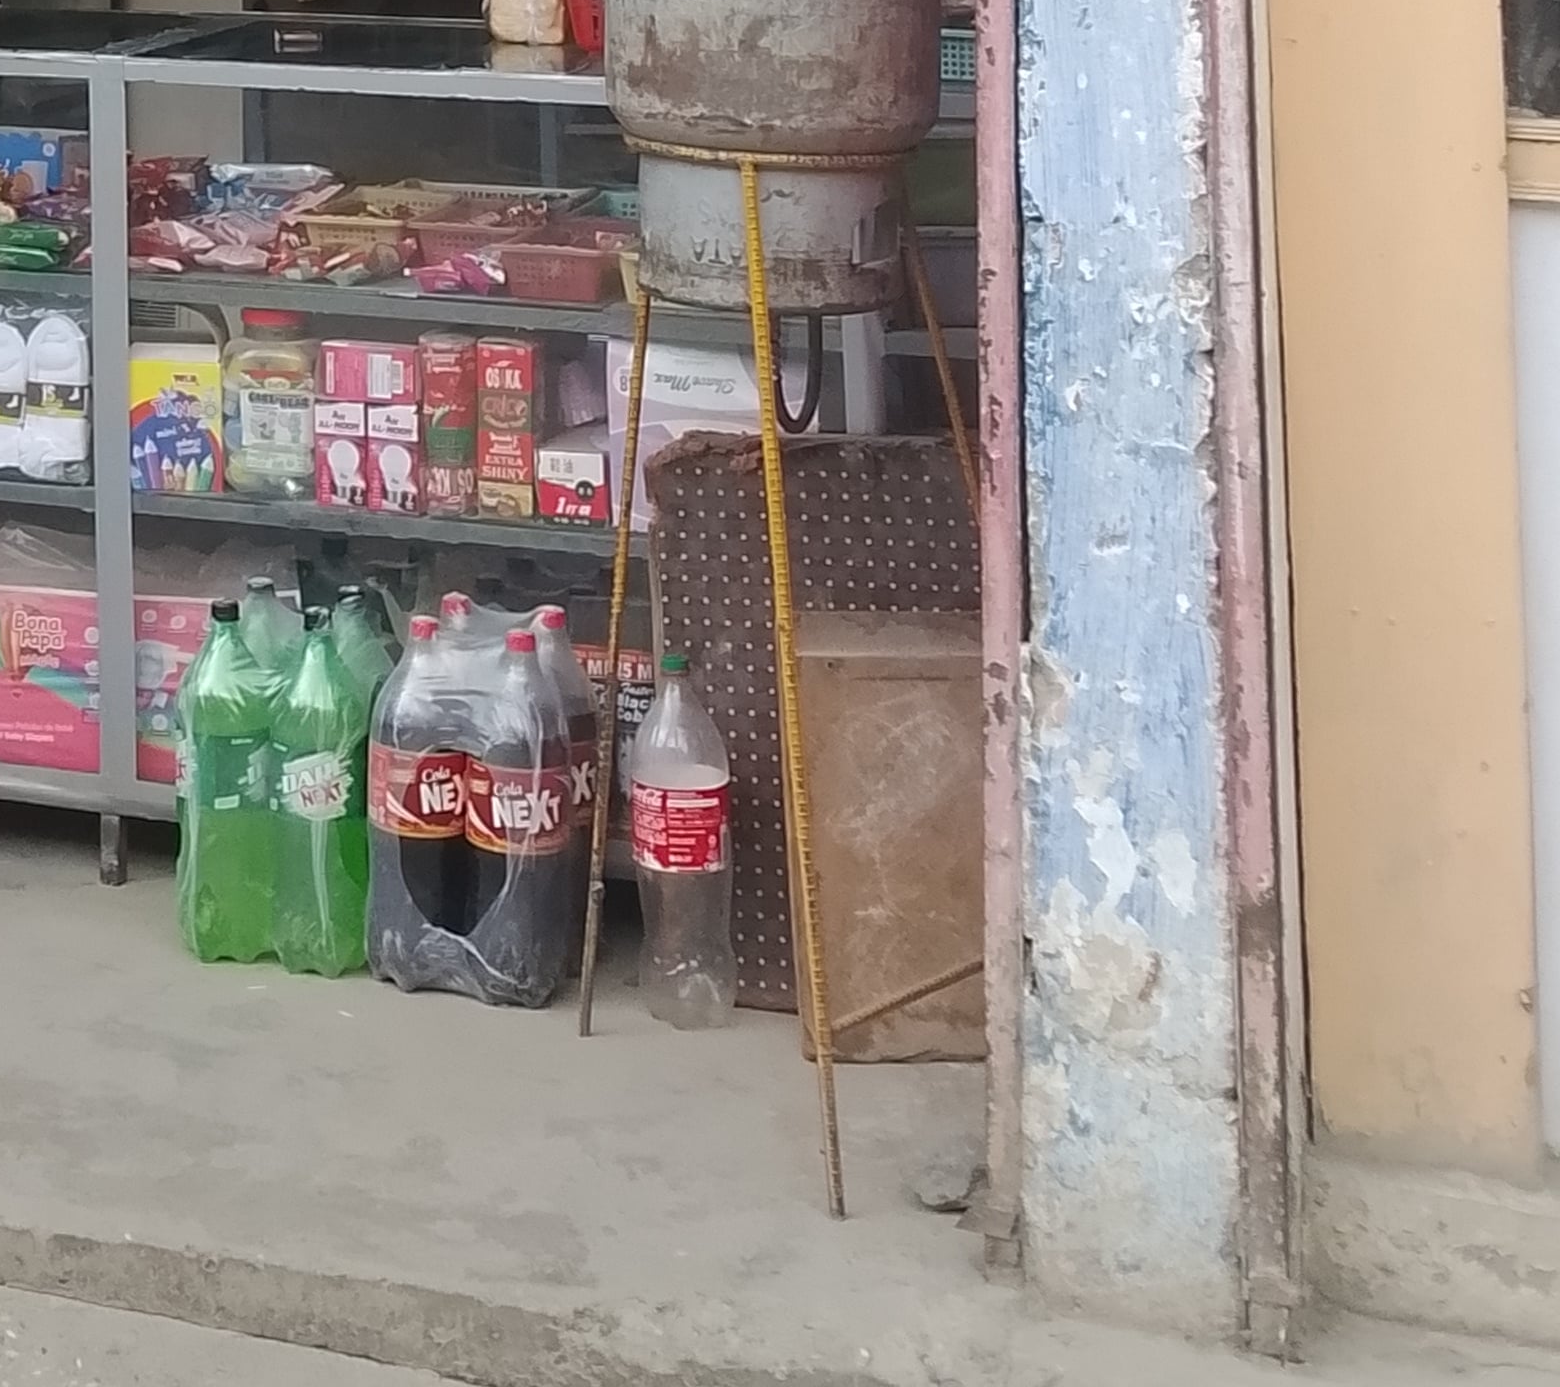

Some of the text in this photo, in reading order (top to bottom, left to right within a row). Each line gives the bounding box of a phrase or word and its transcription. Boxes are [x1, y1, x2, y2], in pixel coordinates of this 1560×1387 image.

[653, 372, 737, 395] Shave Max
[484, 454, 524, 467] EXTRA
[481, 465, 529, 483] SHINY
[12, 610, 63, 632] Bona
[19, 629, 65, 653] Papa
[617, 693, 650, 710] Blac
[617, 707, 644, 723] Cob
[421, 765, 451, 782] Cola
[300, 781, 342, 808] NEXT
[419, 773, 465, 815] NEX
[492, 781, 523, 798] Cola
[491, 789, 562, 835] NEXT
